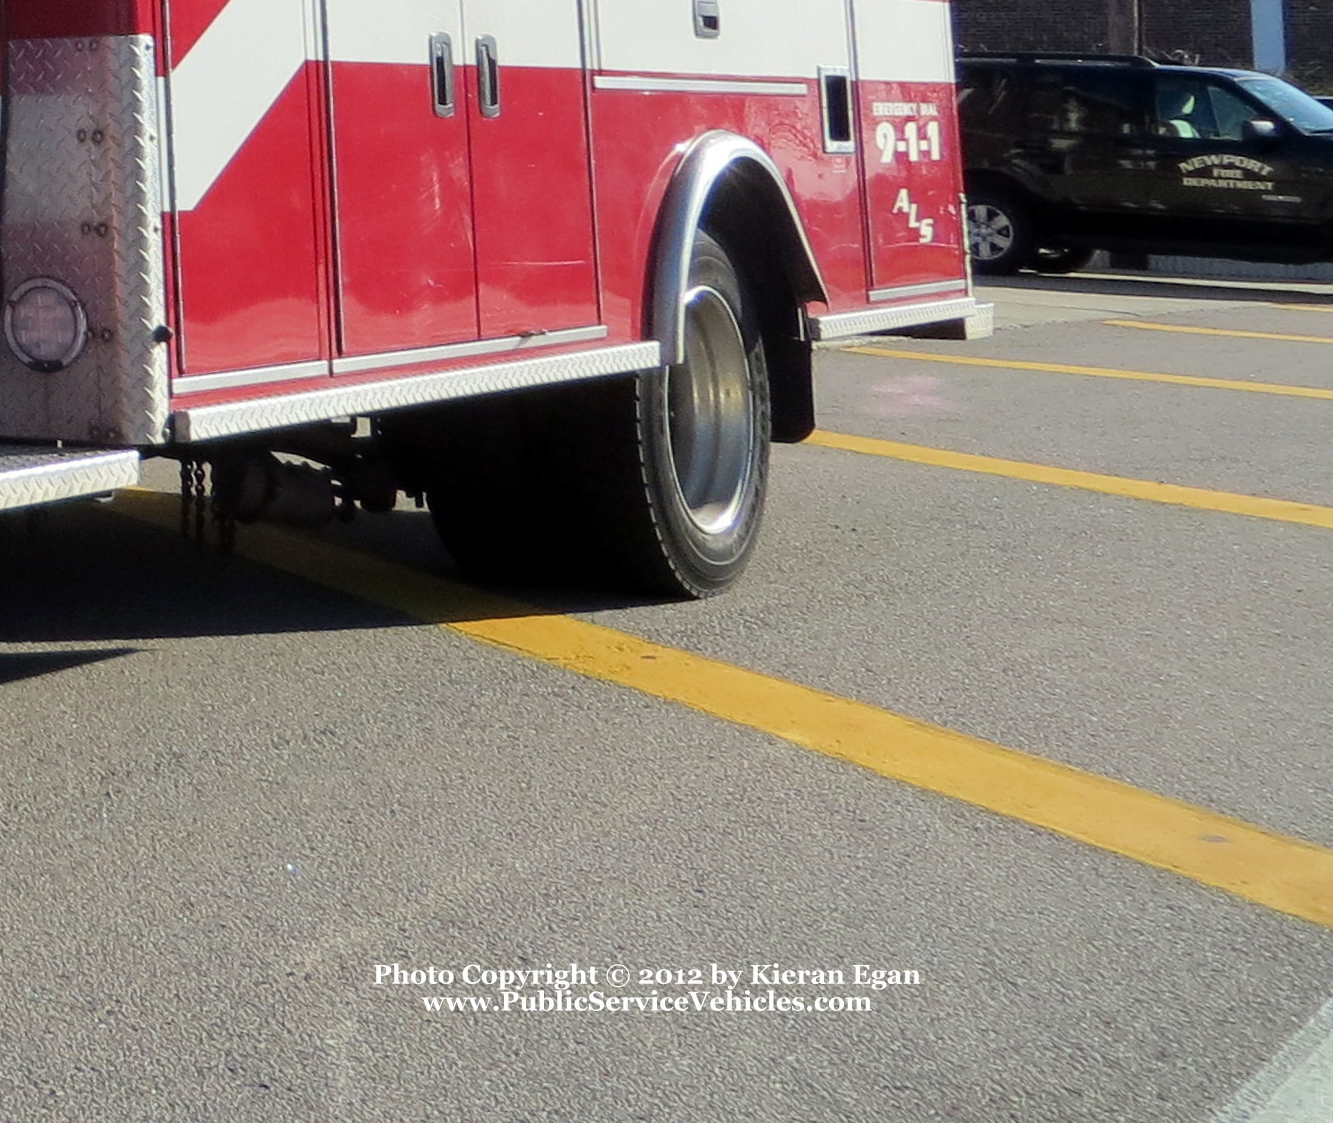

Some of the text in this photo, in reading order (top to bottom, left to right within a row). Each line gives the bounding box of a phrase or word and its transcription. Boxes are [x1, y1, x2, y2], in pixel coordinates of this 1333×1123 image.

[875, 120, 941, 164] 9-1-1
[1178, 154, 1275, 177] NEWPORT
[1212, 168, 1244, 179] FIRE
[1182, 177, 1274, 191] DEPARTMENT
